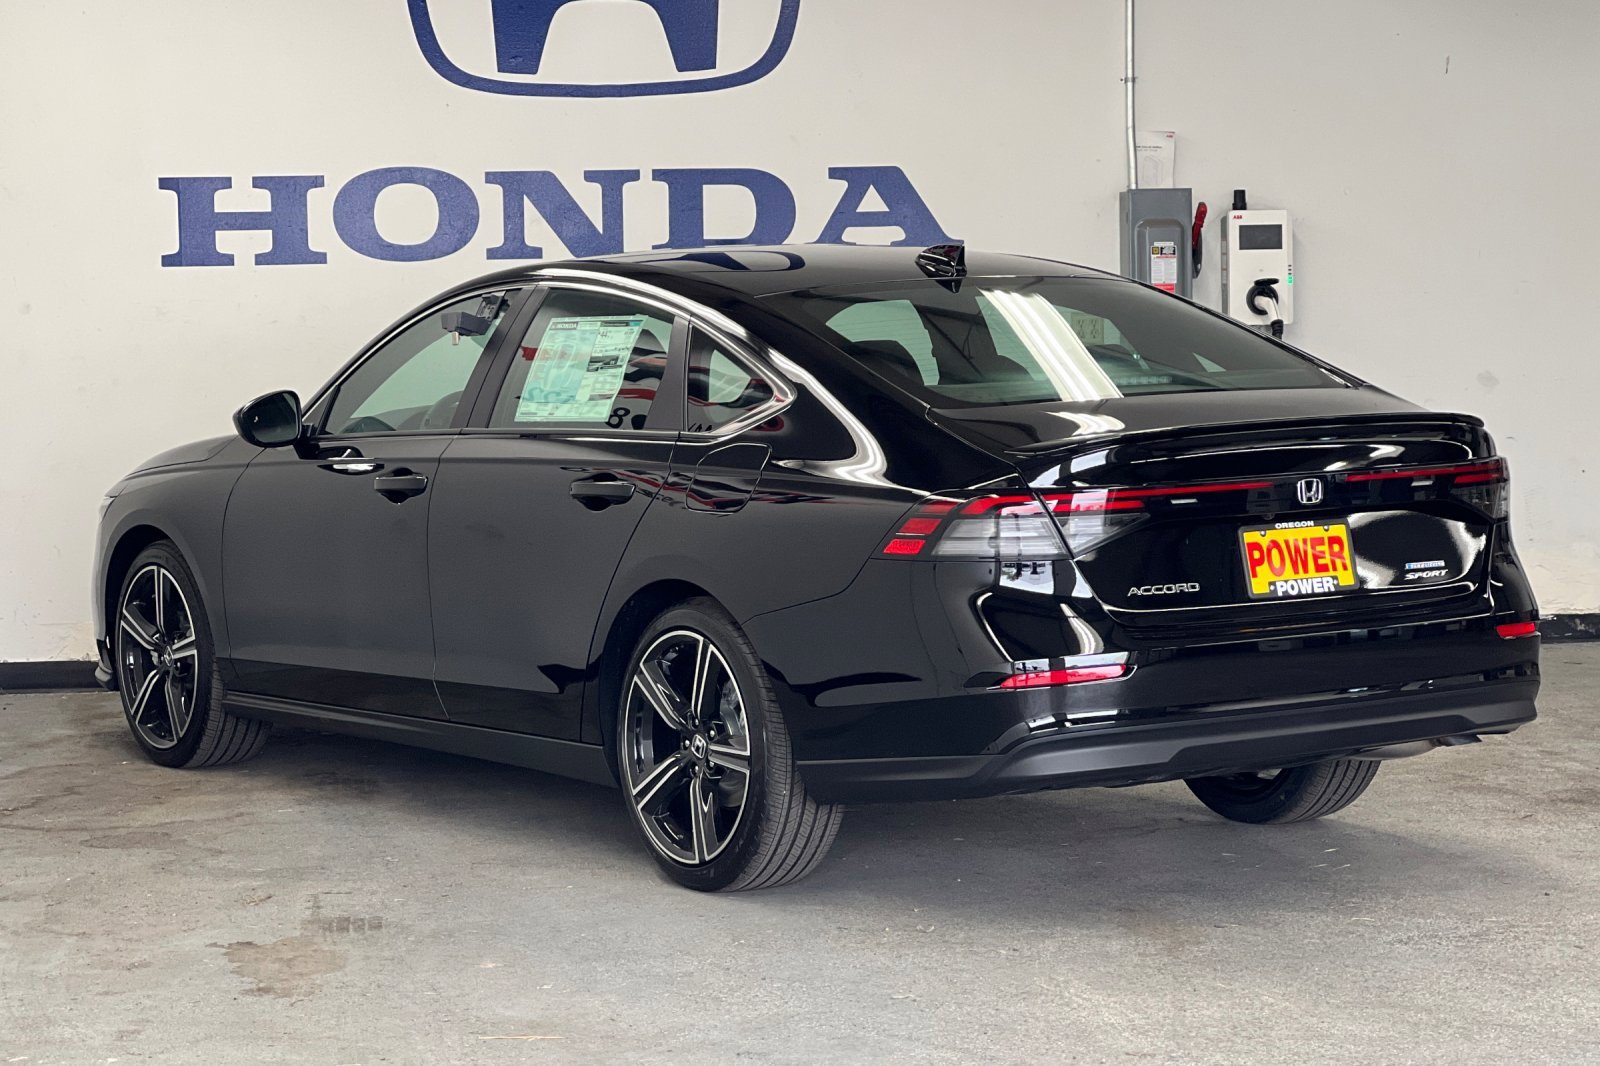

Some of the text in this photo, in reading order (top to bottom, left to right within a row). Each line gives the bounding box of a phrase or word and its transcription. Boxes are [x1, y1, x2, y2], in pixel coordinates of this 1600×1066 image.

[157, 165, 962, 267] HONDA
[1275, 520, 1314, 529] OREGON
[1246, 535, 1348, 579] POWER
[1404, 569, 1448, 580] SPORT
[1127, 582, 1200, 597] ACCORD
[1276, 576, 1335, 596] POWER
